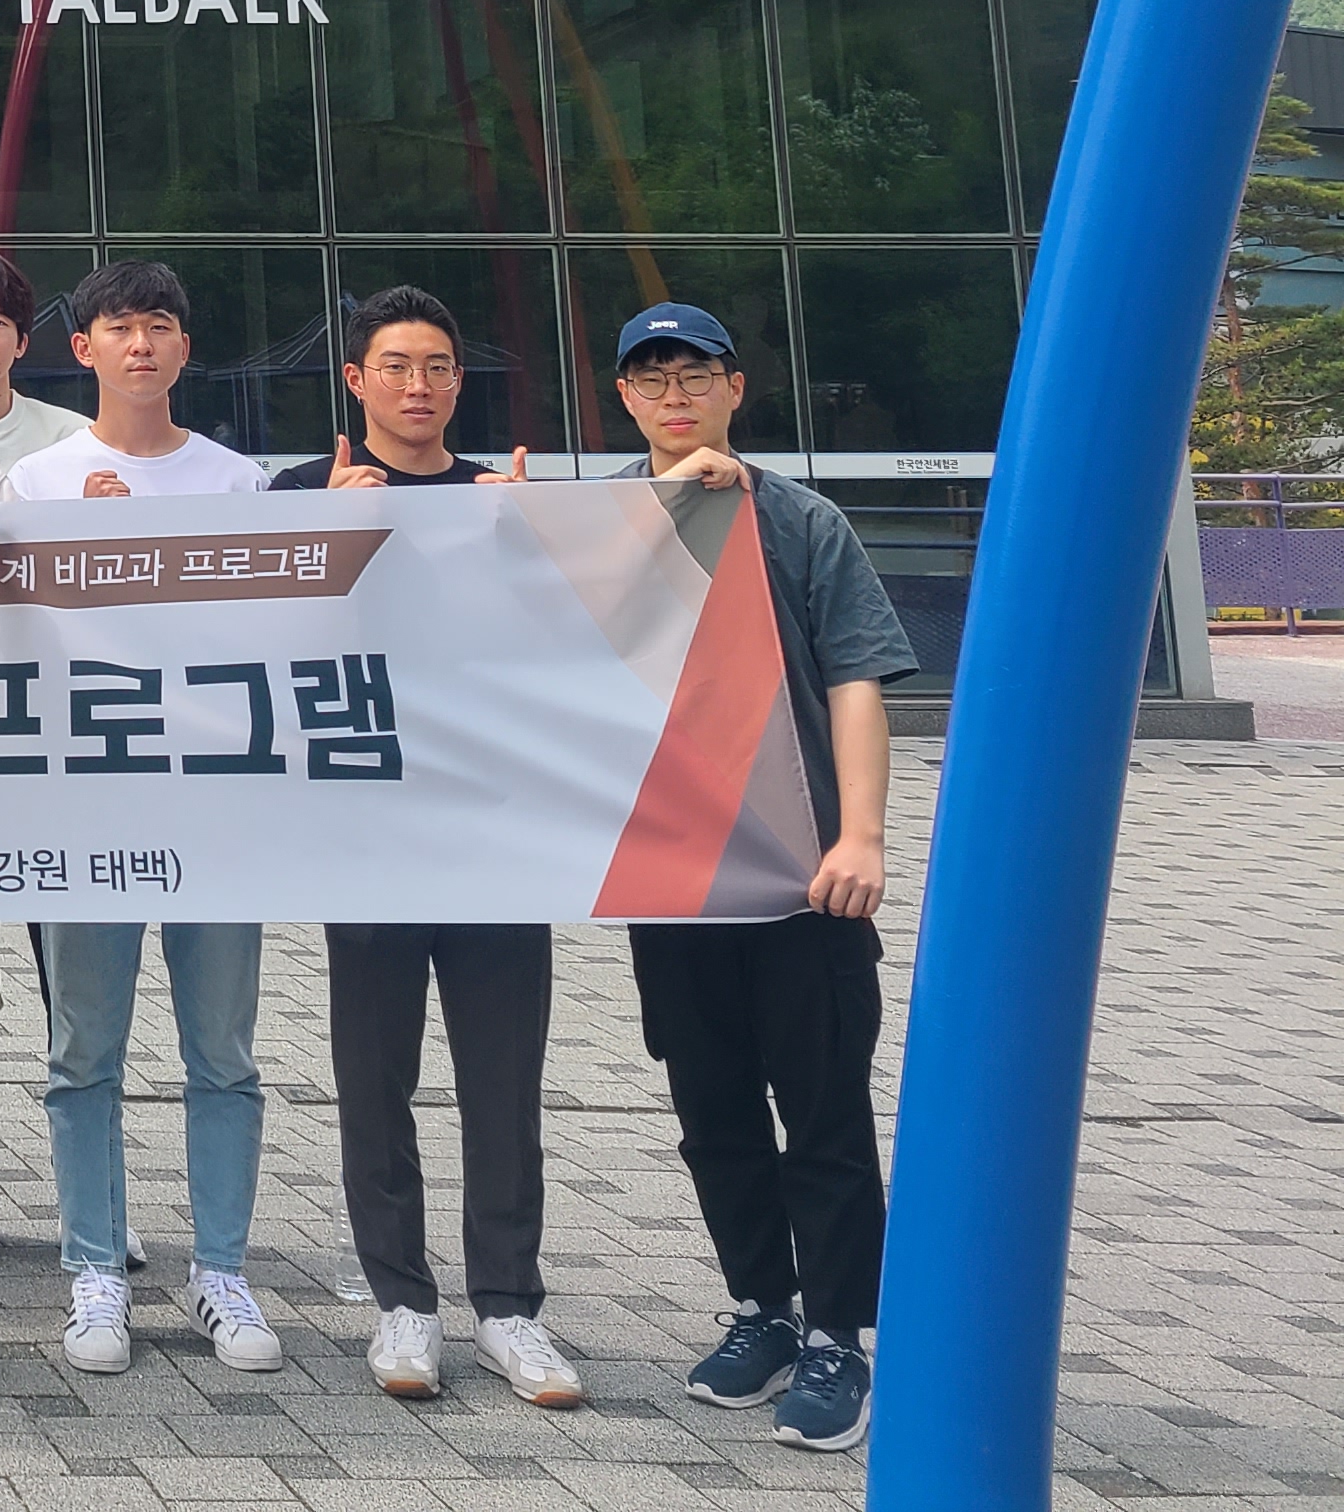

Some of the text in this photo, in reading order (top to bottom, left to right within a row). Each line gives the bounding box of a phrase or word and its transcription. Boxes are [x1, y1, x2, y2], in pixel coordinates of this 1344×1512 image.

[54, 548, 165, 591] 비교과
[178, 542, 329, 581] 프로그램
[89, 847, 184, 894] 태백)
